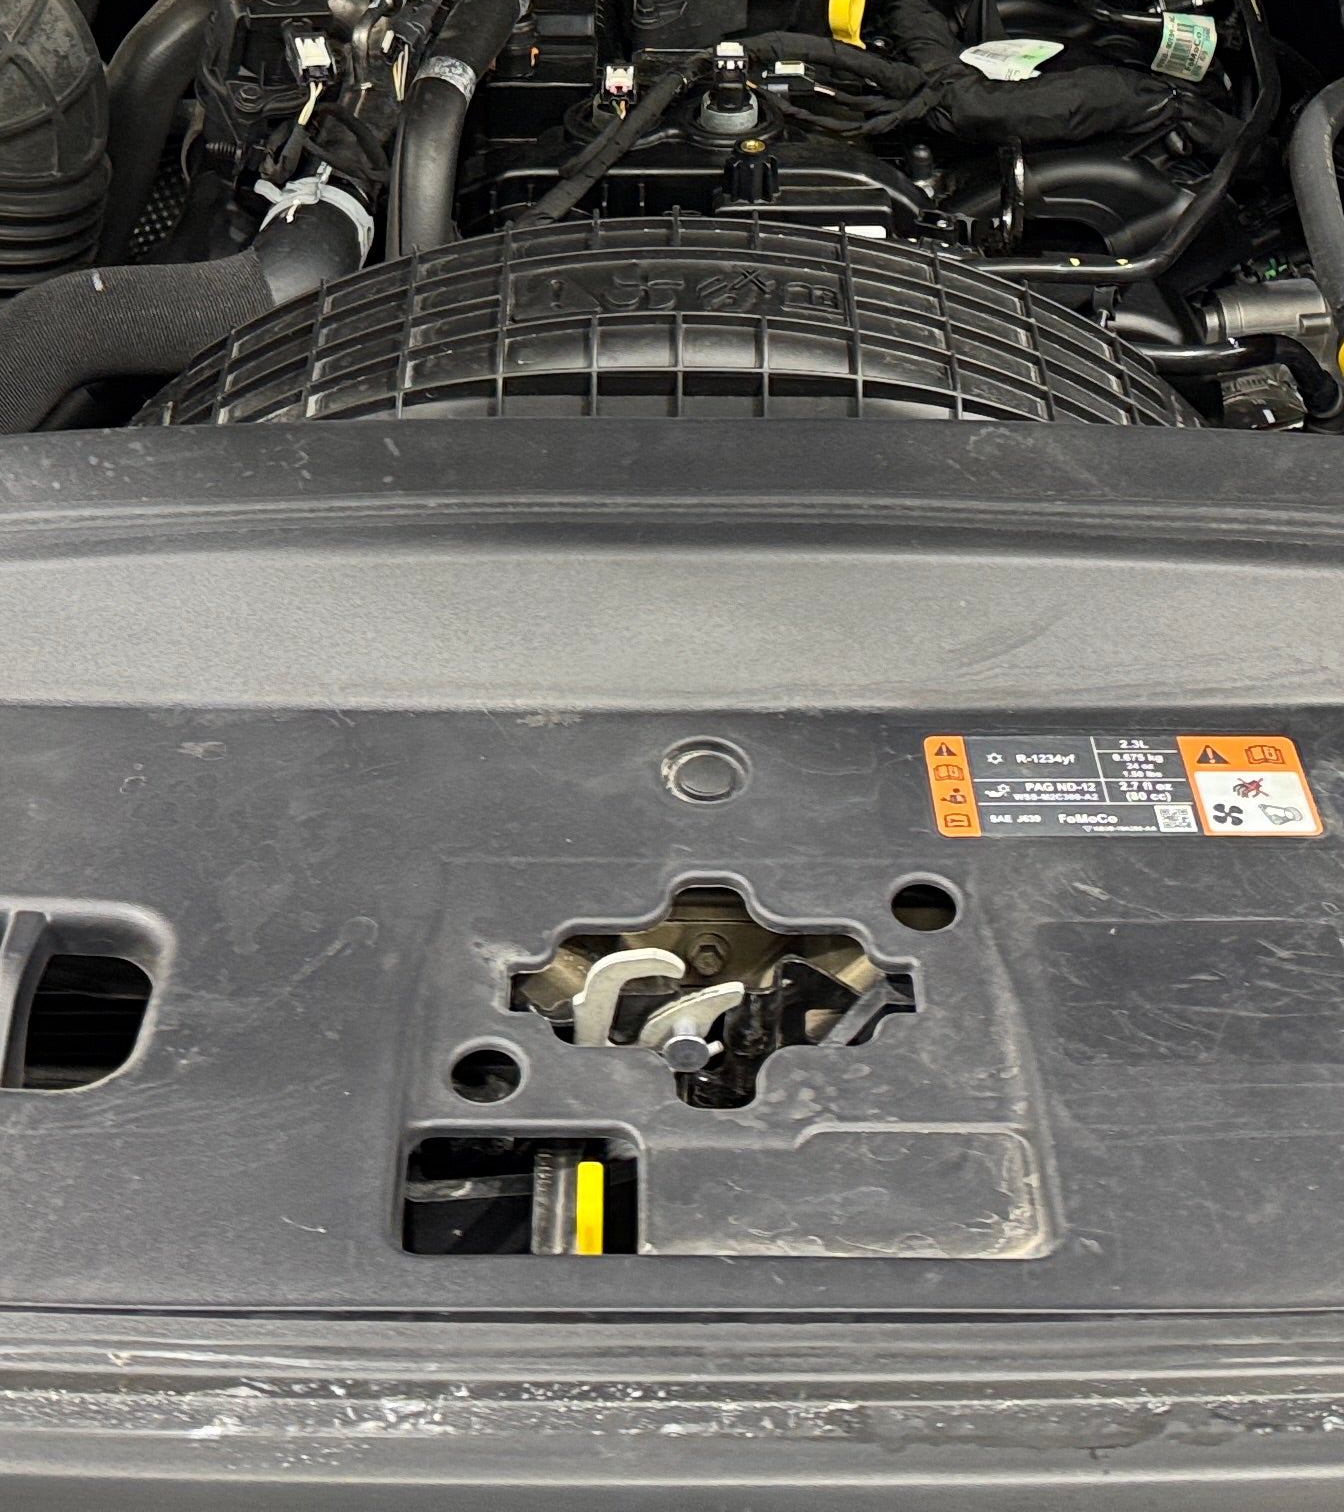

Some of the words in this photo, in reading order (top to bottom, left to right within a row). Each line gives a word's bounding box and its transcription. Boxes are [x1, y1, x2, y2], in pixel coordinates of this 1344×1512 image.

[1184, 31, 1203, 72] FoMoCo
[1118, 739, 1150, 749] 2.3L
[1015, 753, 1076, 766] R-1234yf
[1147, 753, 1165, 764] kg
[1125, 762, 1141, 770] 24
[1024, 782, 1055, 792] PAG
[1056, 782, 1097, 792] ND-12
[1118, 781, 1139, 791] 2.7
[1142, 781, 1154, 791] fl
[1155, 783, 1174, 791] oz
[1149, 791, 1172, 803] cc)
[989, 814, 1013, 824] SAE
[1057, 813, 1119, 824] FoMoCo
